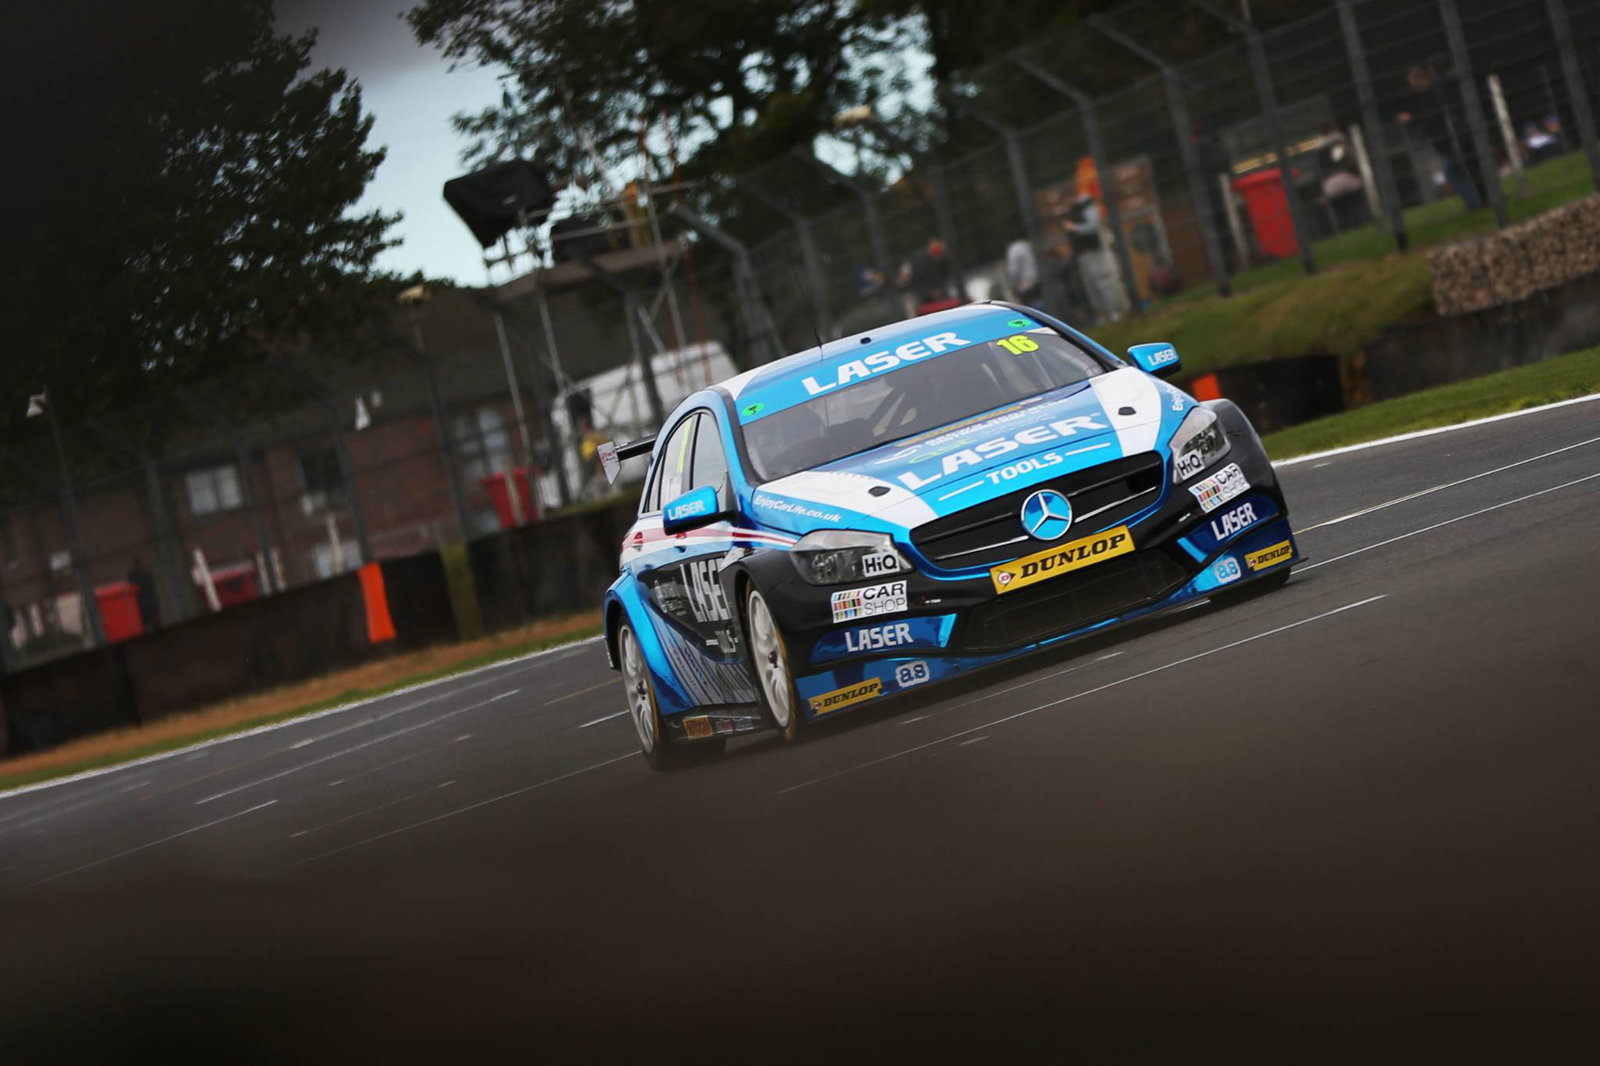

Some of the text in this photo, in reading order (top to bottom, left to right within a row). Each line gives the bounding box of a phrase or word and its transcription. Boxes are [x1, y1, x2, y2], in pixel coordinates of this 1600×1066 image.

[997, 335, 1039, 355] 16
[802, 331, 971, 396] LASER
[898, 414, 1108, 490] LASER
[1177, 452, 1202, 476] HiQ
[986, 452, 1064, 485] TOOLS
[1215, 464, 1240, 484] CAR
[668, 500, 706, 521] LASER
[754, 495, 842, 523] EnjoyCarLife.co.uk
[1211, 502, 1258, 541] LASER
[864, 554, 898, 574] HiQ
[1020, 533, 1126, 579] DUNLOP
[1257, 546, 1290, 564] DUNLOP
[863, 583, 905, 600] CAR
[864, 597, 906, 615] SHOP
[845, 623, 914, 652] LASER
[823, 682, 879, 708] DUNLOP
